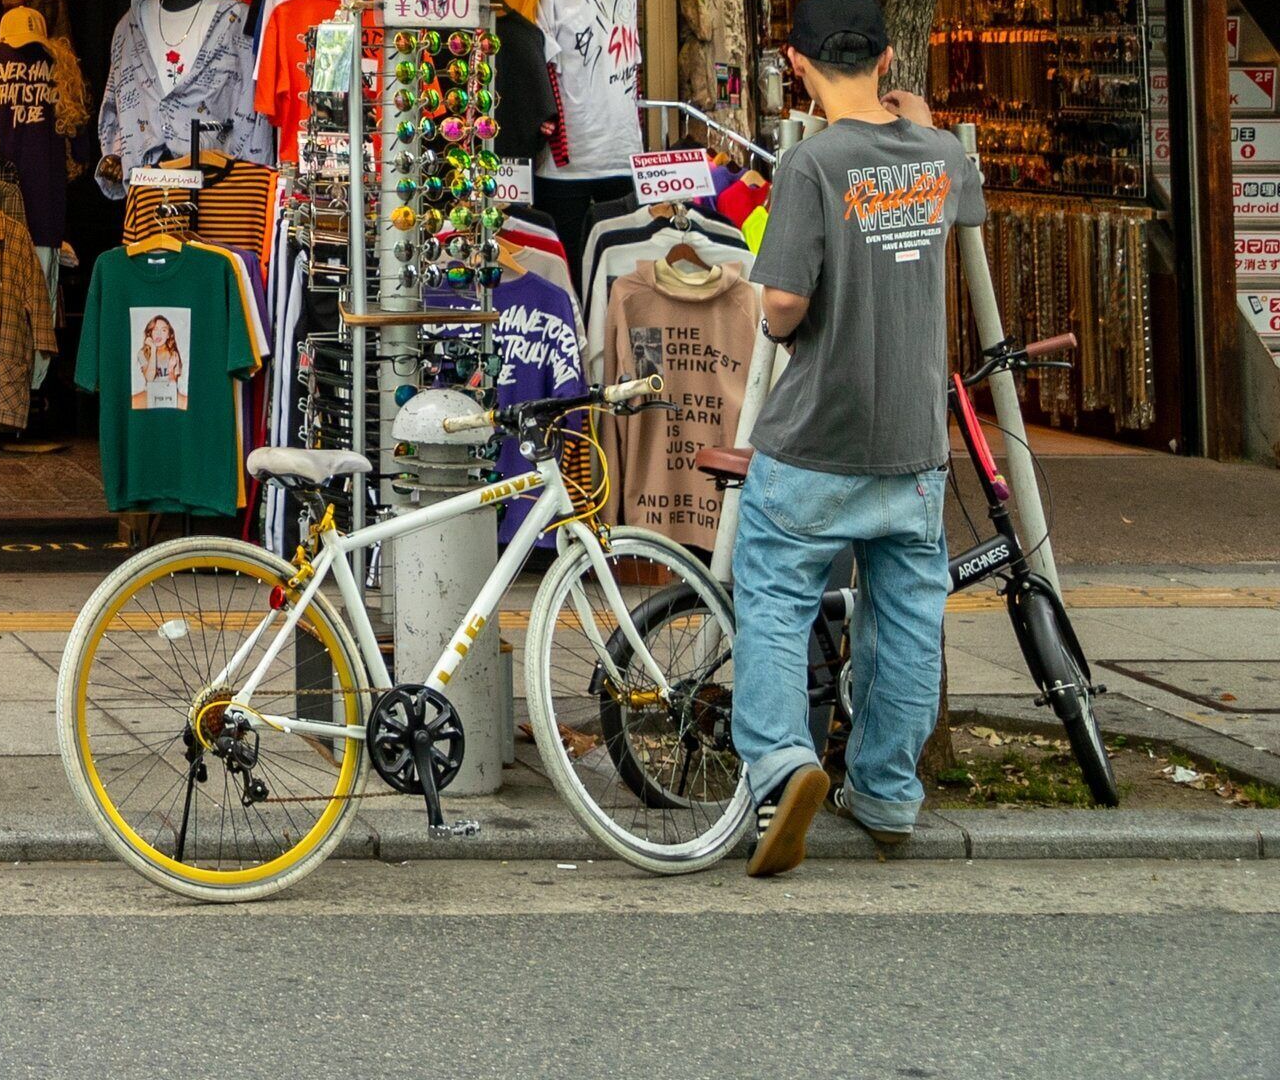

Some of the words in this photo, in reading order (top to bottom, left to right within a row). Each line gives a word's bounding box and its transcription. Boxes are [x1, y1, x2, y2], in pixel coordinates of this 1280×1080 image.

[28, 60, 57, 82] HAV
[1255, 72, 1272, 82] 2F
[25, 105, 44, 124] BE
[634, 154, 671, 167] Special
[675, 151, 702, 163] SALE
[134, 173, 155, 183] New
[160, 174, 199, 184] Arrival
[847, 160, 945, 197] PERVERT
[641, 177, 694, 197] 6,900
[1233, 202, 1279, 214] ndroid
[866, 235, 881, 243] EVEN
[894, 231, 920, 239] HARDEST
[882, 242, 898, 250] HAVE
[499, 305, 546, 335] HAVE
[665, 327, 699, 340] THE
[667, 409, 721, 426] LEARN
[667, 426, 680, 437] IS
[667, 458, 697, 471] LOV
[637, 494, 669, 508] AND
[674, 494, 693, 508] BE
[646, 511, 662, 525] IN
[670, 511, 720, 530] RETUR
[958, 545, 1009, 581] ARCHNESS
